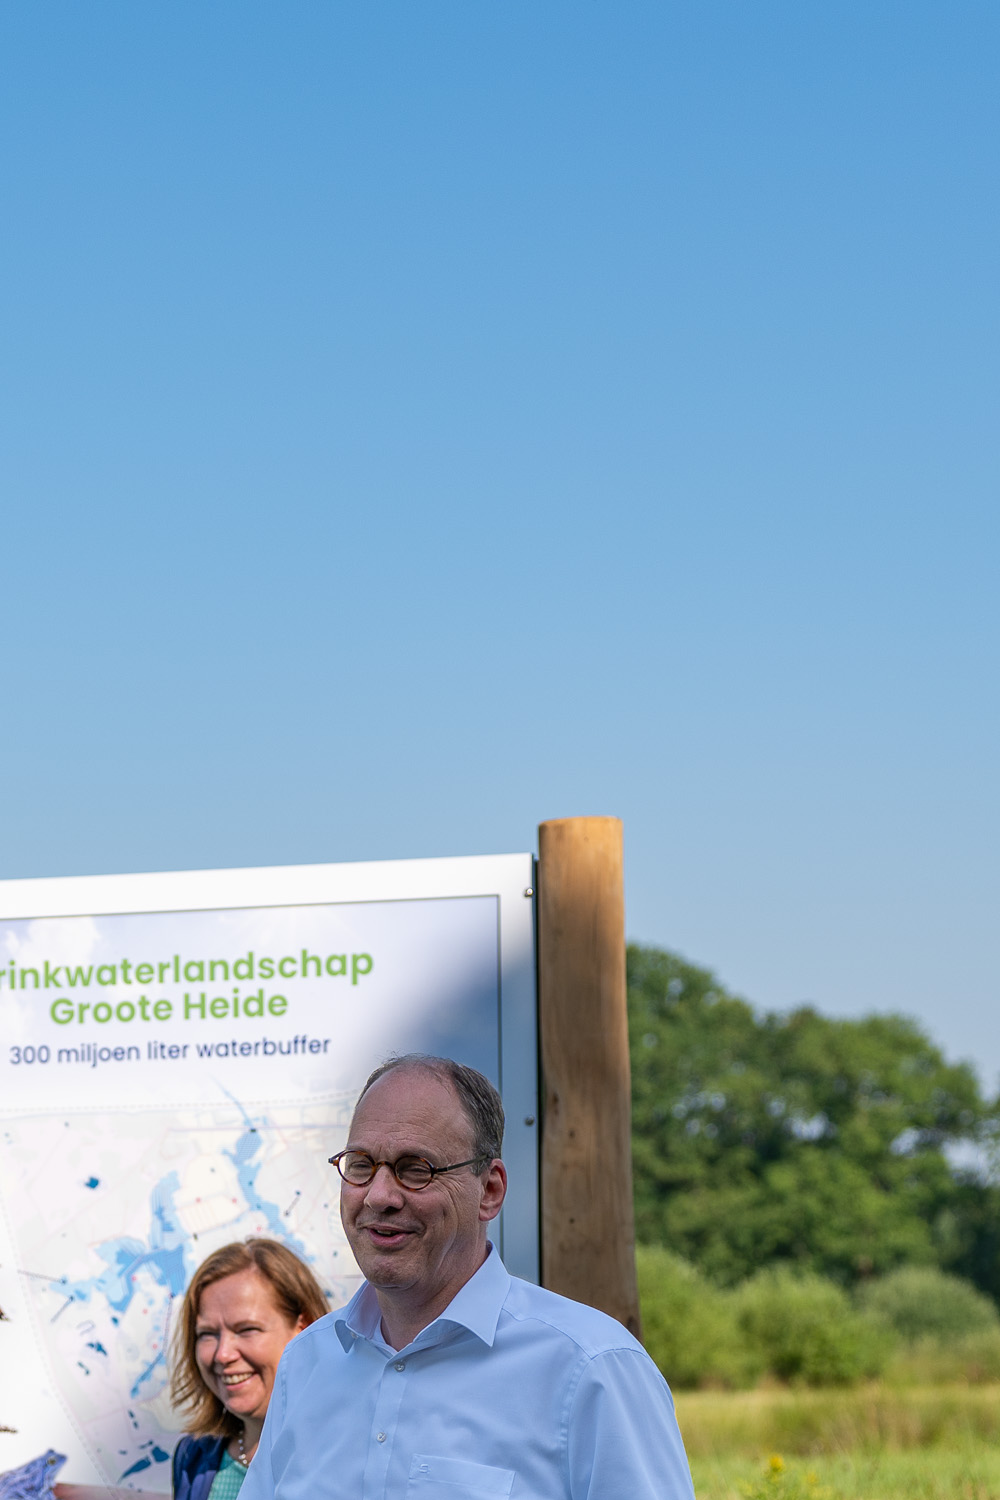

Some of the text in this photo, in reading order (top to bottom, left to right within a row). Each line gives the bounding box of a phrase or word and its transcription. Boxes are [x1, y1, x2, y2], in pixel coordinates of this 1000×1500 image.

[50, 987, 290, 1025] Groote Heide
[9, 1035, 331, 1068] 300 miljoen liter waterbuffer
